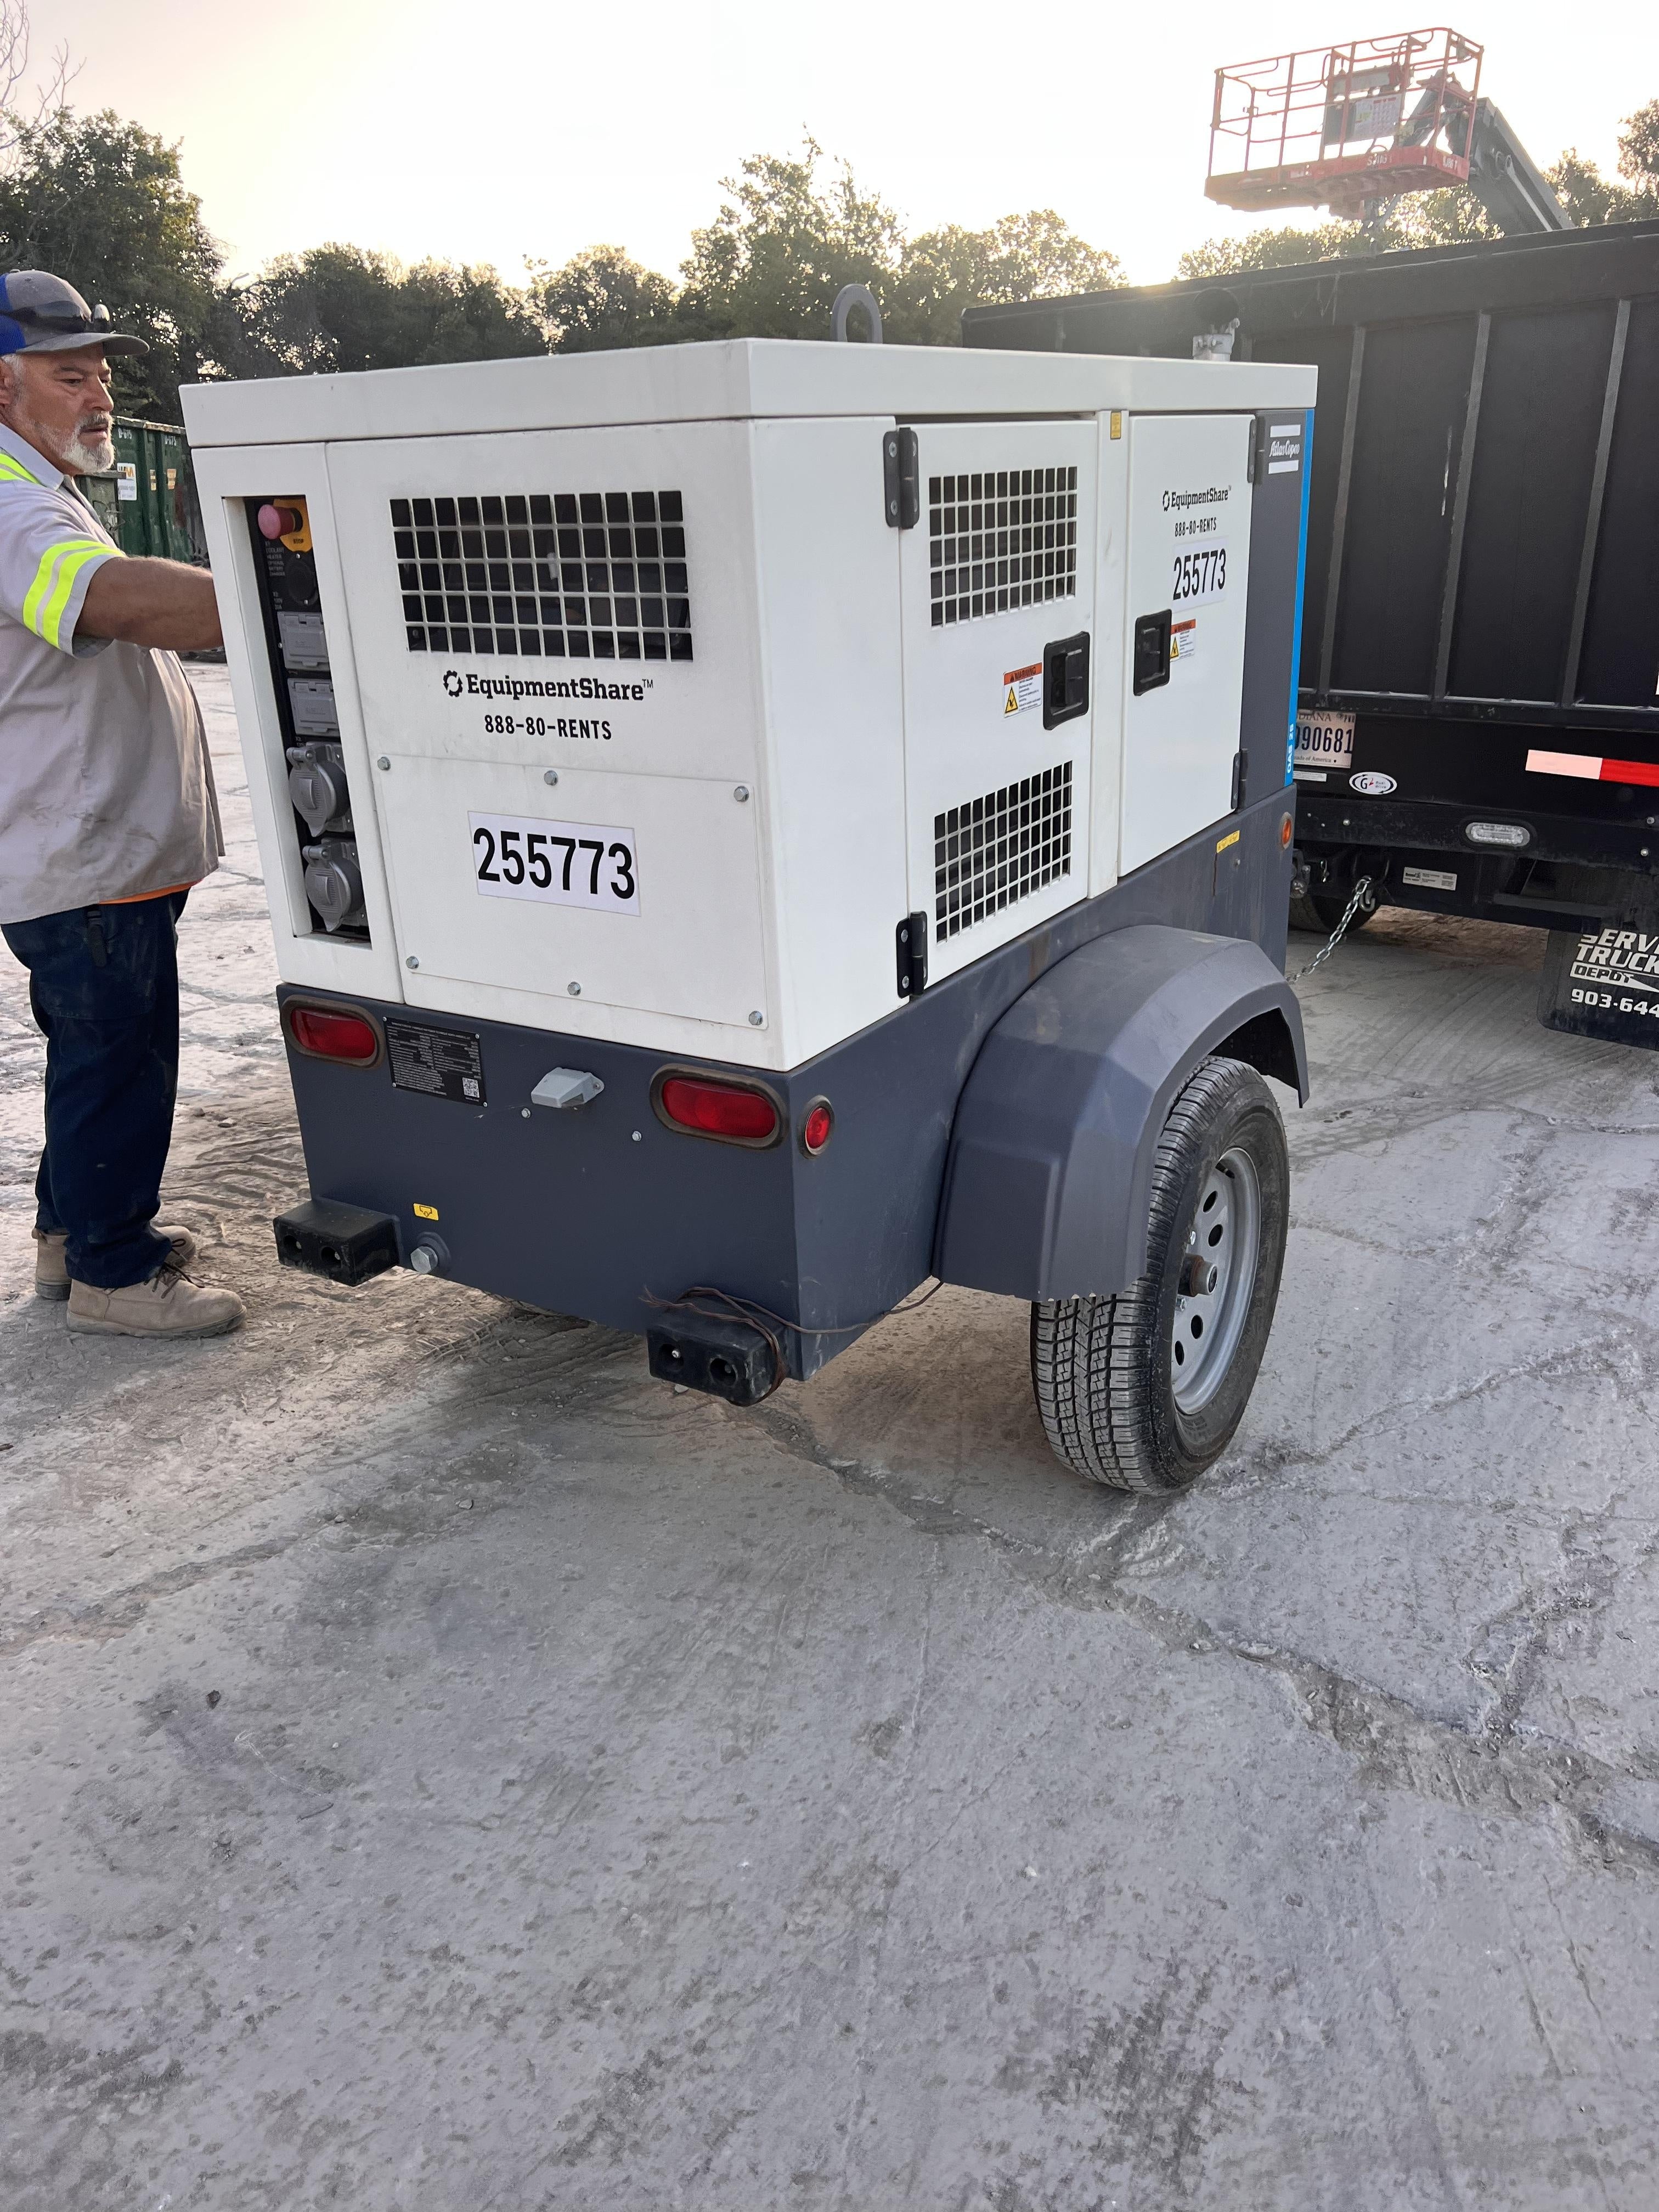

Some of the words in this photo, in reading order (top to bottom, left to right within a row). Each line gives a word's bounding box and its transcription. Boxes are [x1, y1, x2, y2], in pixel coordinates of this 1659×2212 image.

[1171, 487, 1229, 510] EquipmentShare
[1175, 517, 1217, 537] 888-80-RENTS
[1173, 548, 1226, 601] 255773
[484, 715, 612, 741] 888-80-RENTS
[473, 827, 635, 900] 255773
[1576, 944, 1659, 974] TRUCK
[1574, 965, 1634, 984] DEPOT
